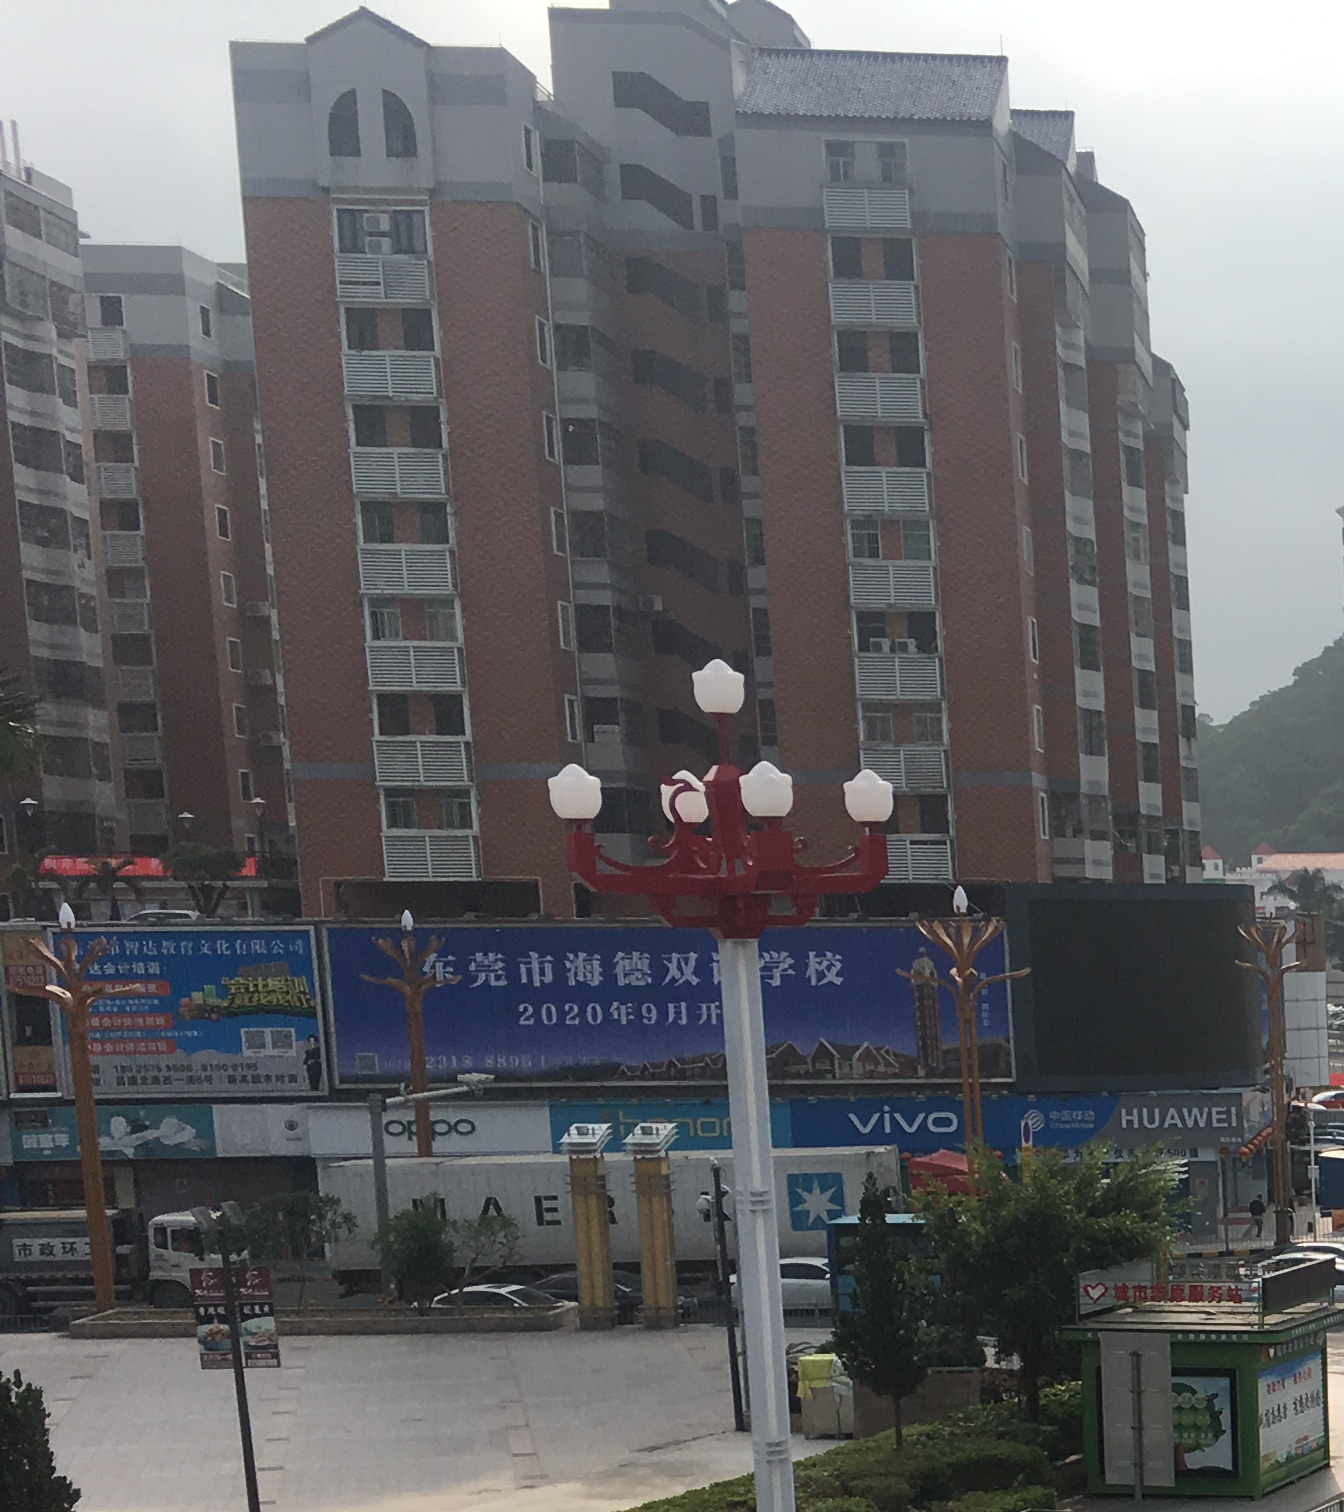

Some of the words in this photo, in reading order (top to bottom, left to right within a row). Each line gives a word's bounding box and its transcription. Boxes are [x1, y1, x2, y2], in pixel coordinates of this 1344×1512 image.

[79, 938, 305, 956] 市智达教育文化有限公司
[423, 951, 845, 988] 东莞市海德双学校
[618, 1109, 732, 1137] hnor
[848, 1105, 959, 1134] vivo
[1049, 1110, 1095, 1121] 中国移动
[1121, 1106, 1238, 1129] HUAWEI
[1113, 1282, 1243, 1304] 城市志愿服务站
